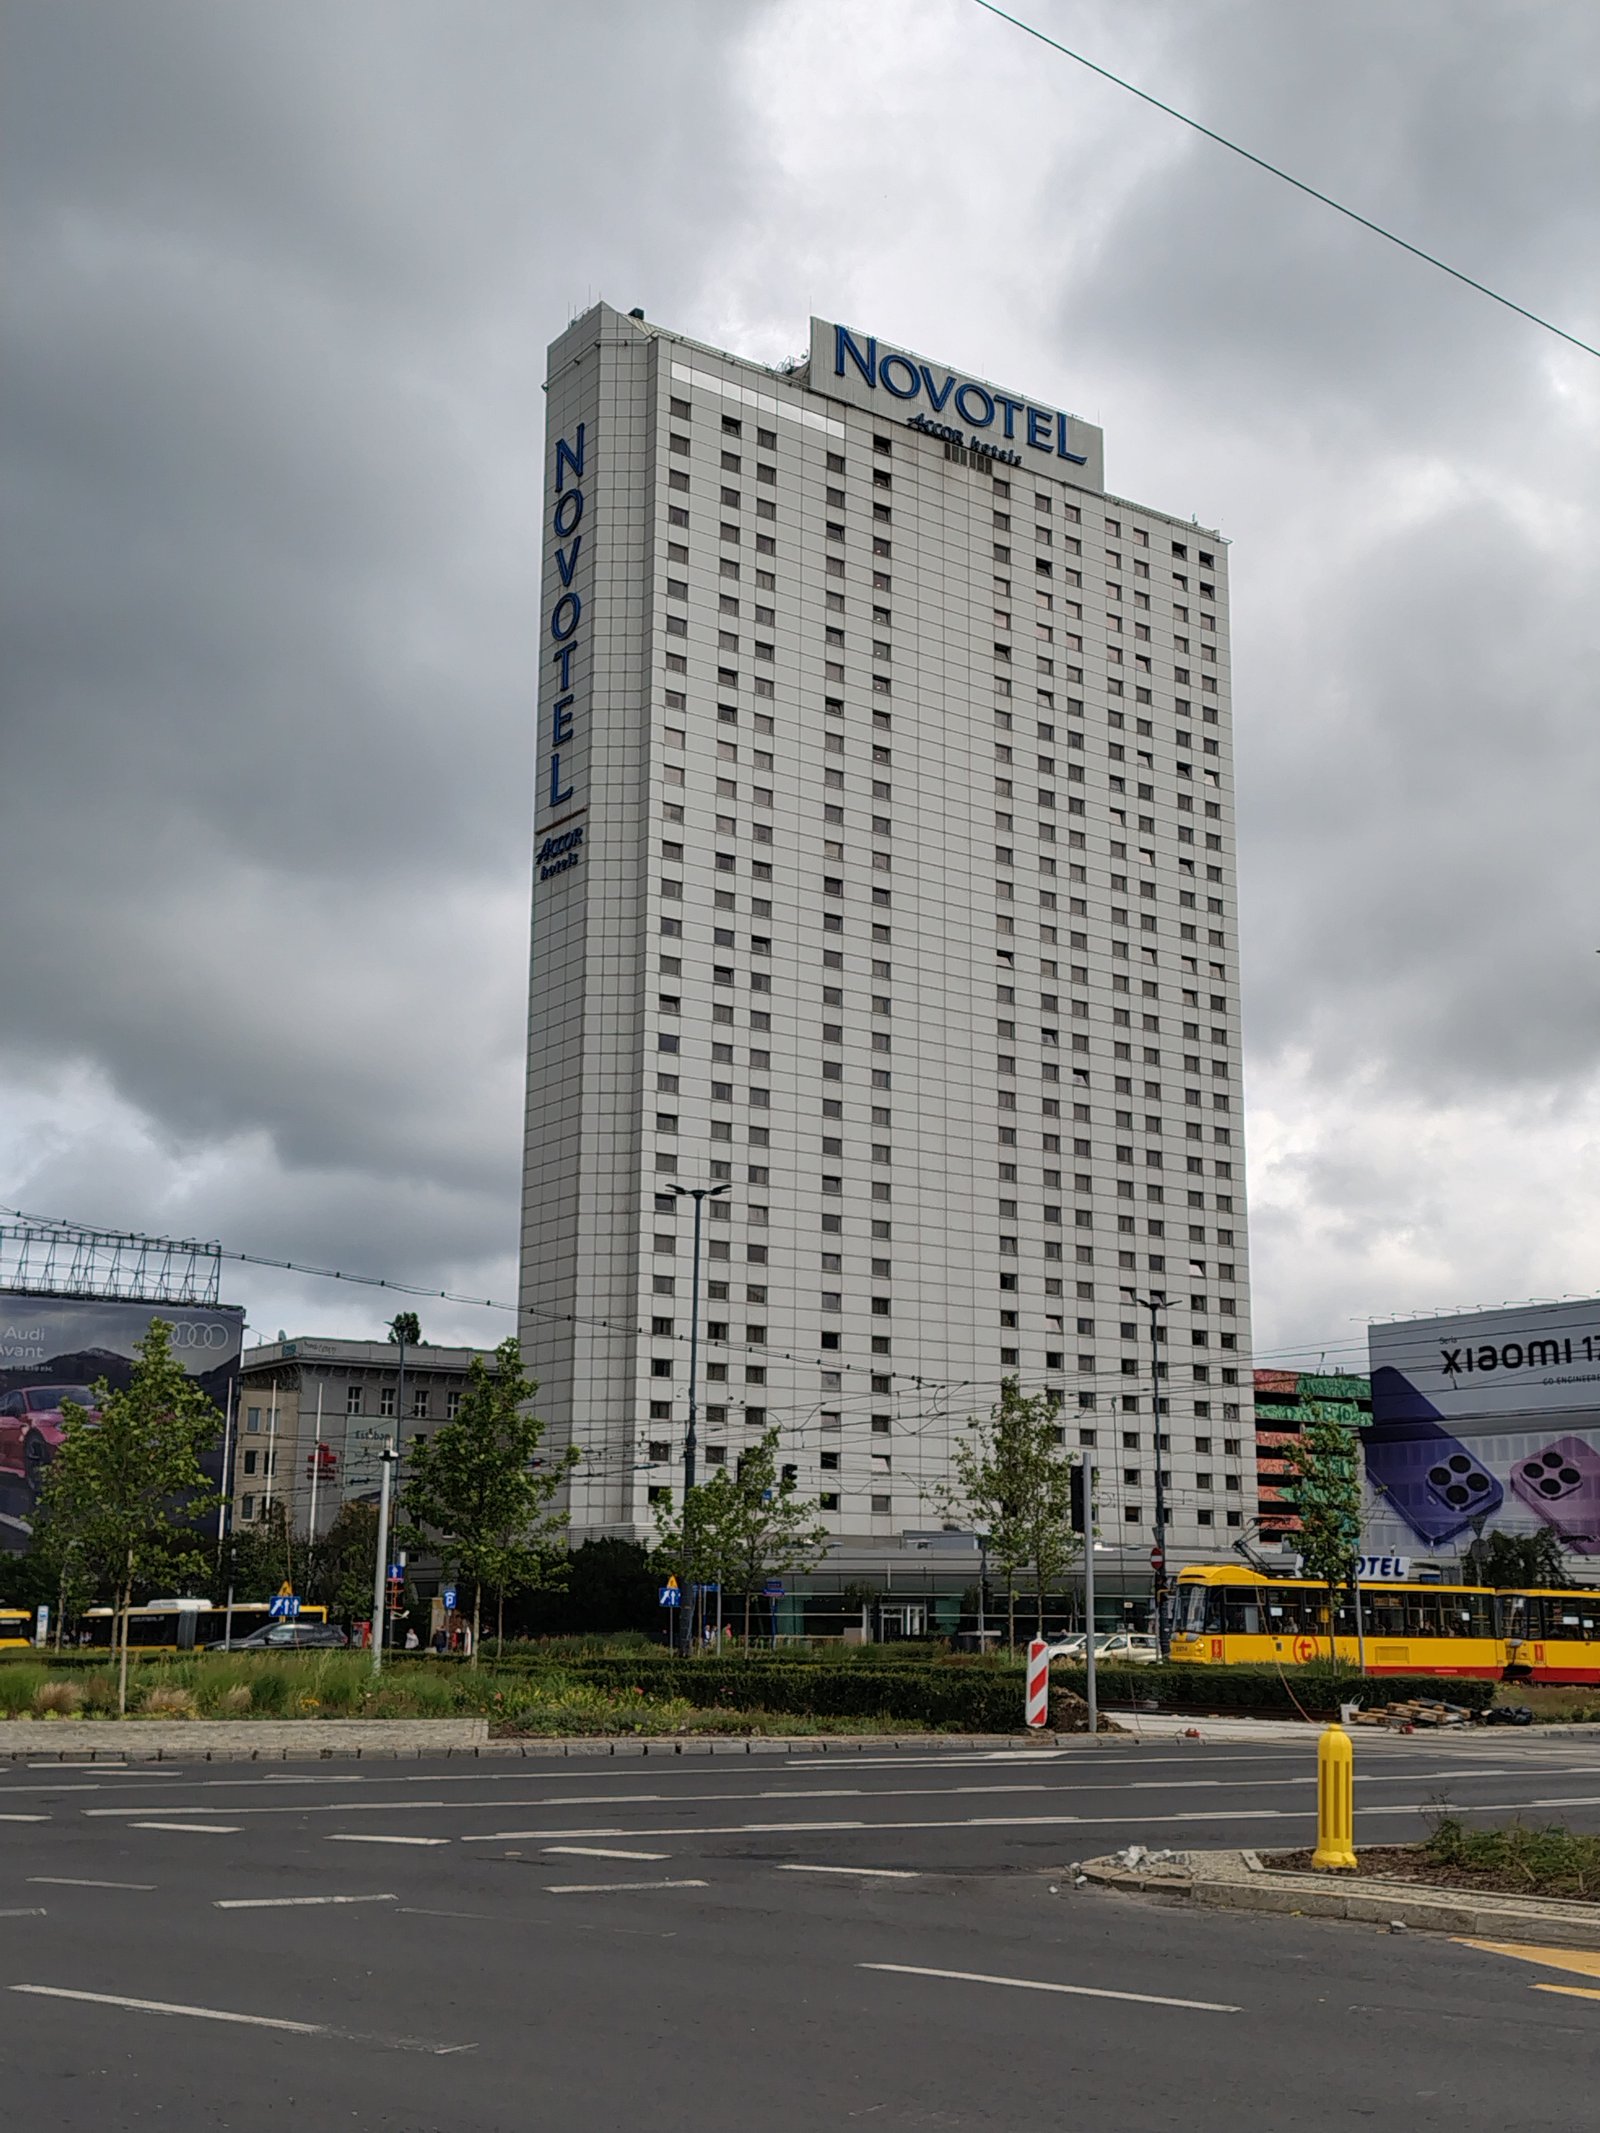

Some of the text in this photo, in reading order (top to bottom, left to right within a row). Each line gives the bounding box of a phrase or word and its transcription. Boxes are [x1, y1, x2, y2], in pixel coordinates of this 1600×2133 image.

[834, 323, 1088, 465] NOVOTEL
[970, 435, 1022, 466] hotels
[549, 422, 585, 808] NOVOTEL
[540, 852, 579, 881] hotels
[3, 1325, 45, 1341] Audi
